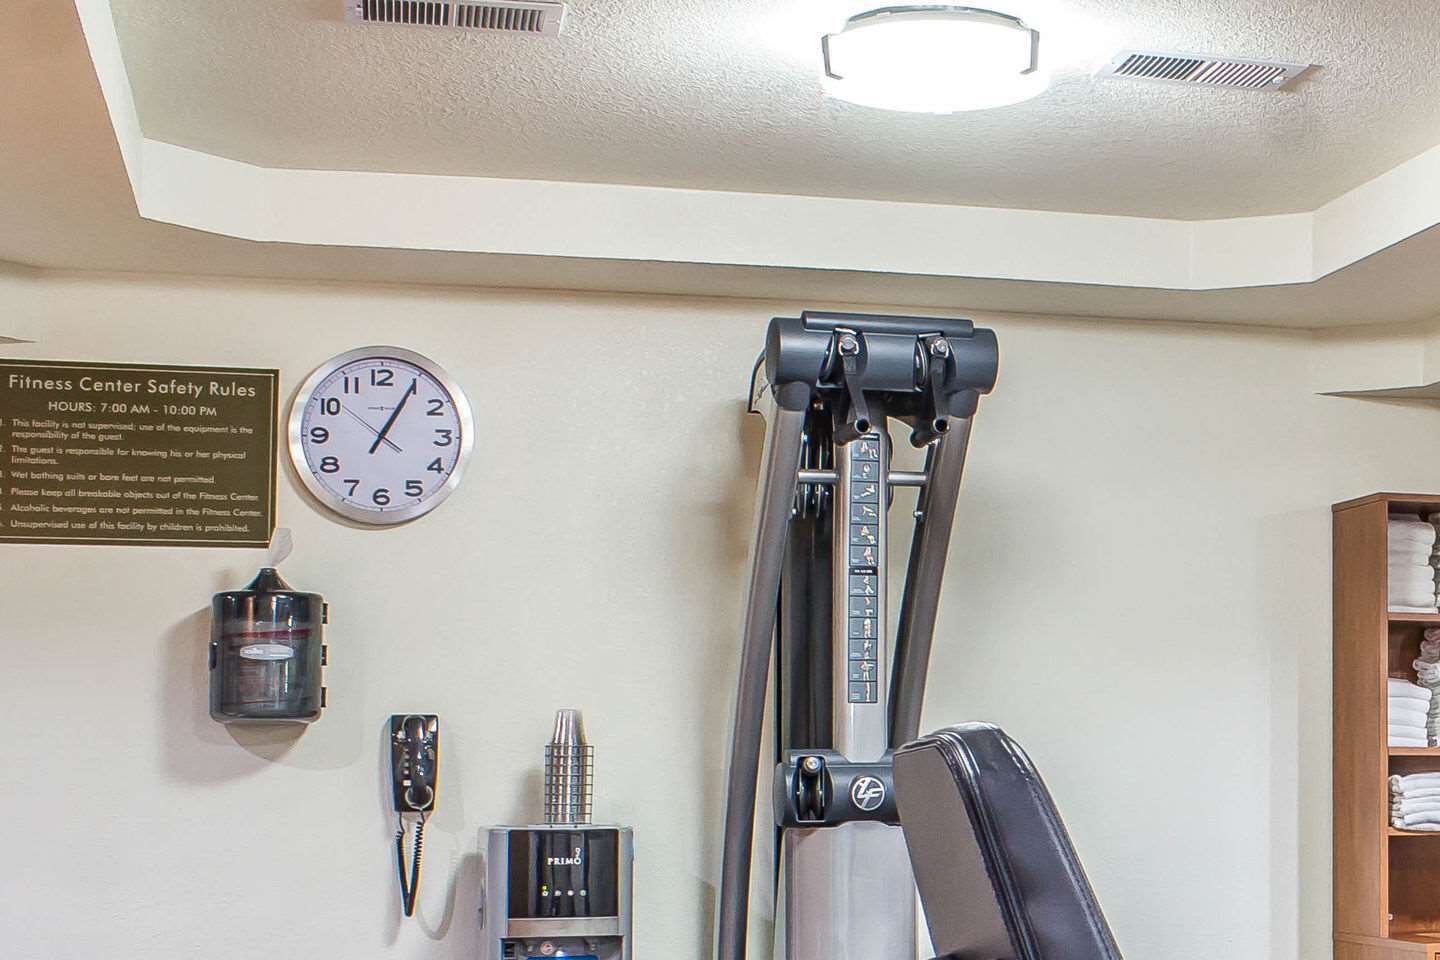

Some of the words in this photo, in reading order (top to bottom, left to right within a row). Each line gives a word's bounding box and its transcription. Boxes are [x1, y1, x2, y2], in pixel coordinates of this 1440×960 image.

[9, 374, 73, 390] Fitness
[79, 377, 141, 393] Center
[147, 379, 203, 398] Safety
[209, 381, 256, 397] Rules
[344, 377, 359, 394] 11
[371, 369, 394, 387] 12
[48, 401, 96, 413] HOURS:
[100, 402, 128, 414] 7:00
[130, 404, 150, 414] AM
[163, 404, 196, 416] 10:00
[199, 406, 217, 417] PM
[320, 398, 341, 416] 10
[426, 399, 444, 417] 2
[310, 427, 329, 444] 9
[433, 429, 452, 447] 3
[320, 456, 340, 474] 8
[427, 457, 444, 474] 4
[343, 479, 360, 496] 7
[404, 480, 423, 497] 5
[372, 488, 390, 506] 6
[547, 856, 582, 865] PRIMO
